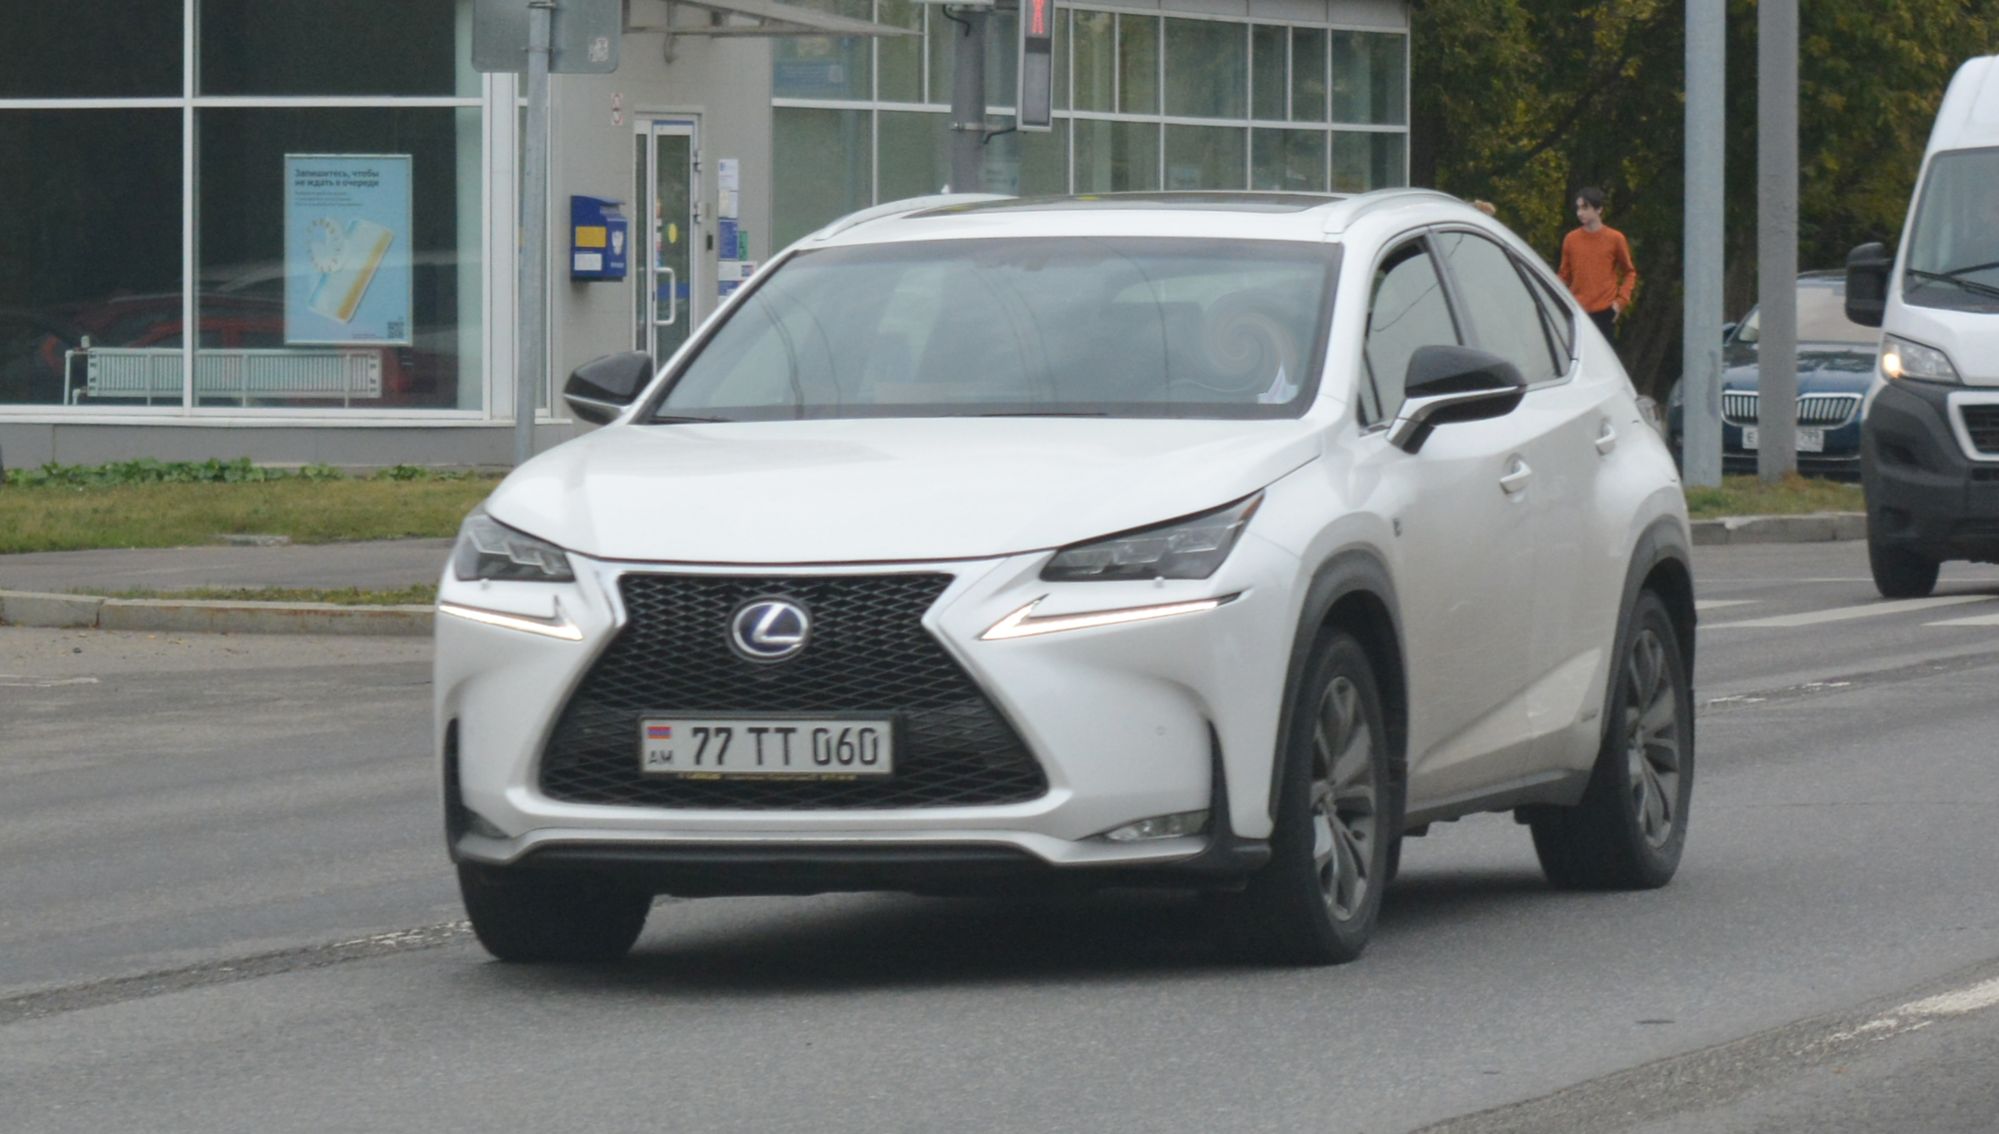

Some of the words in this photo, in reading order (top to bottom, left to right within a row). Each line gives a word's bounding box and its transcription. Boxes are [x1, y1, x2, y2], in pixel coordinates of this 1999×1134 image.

[649, 750, 674, 764] AM
[692, 727, 733, 766] 77
[747, 727, 797, 766] TT
[812, 727, 878, 766] 060
